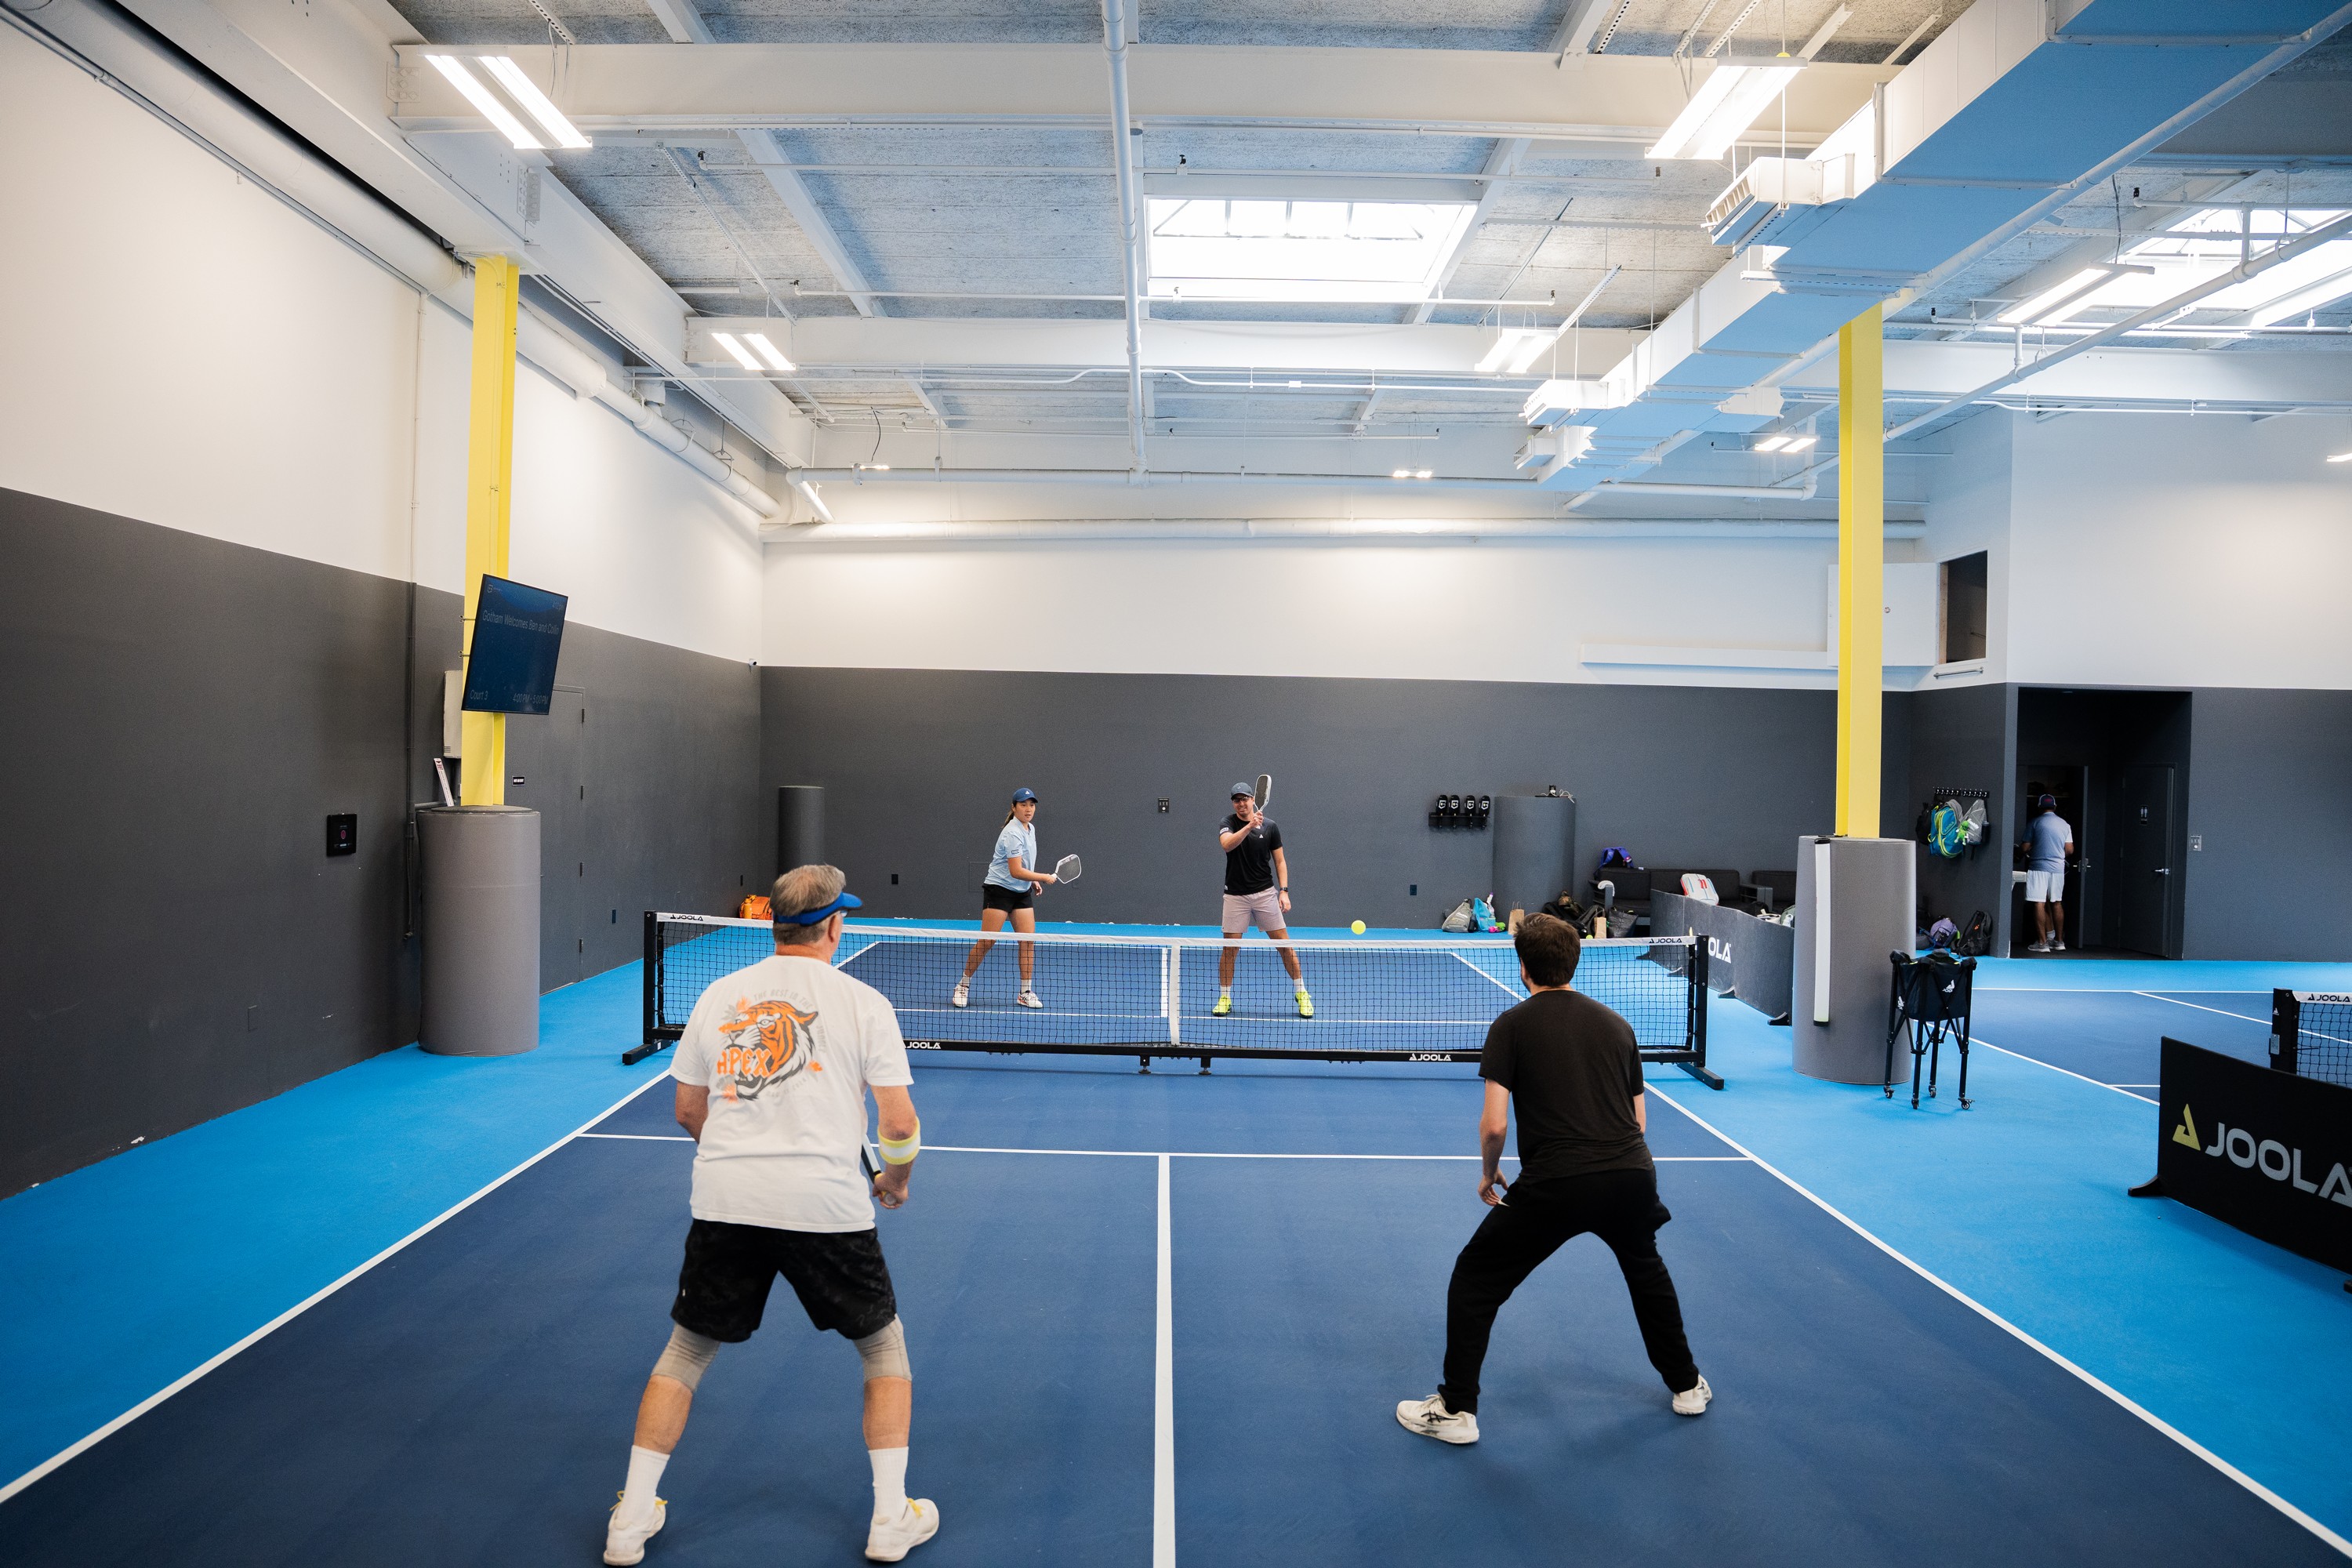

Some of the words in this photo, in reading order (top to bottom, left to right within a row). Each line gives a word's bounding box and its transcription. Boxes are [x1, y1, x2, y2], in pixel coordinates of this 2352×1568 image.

[482, 610, 503, 625] Gotham
[504, 614, 528, 630] Welcomes
[528, 619, 538, 630] Ben
[538, 622, 547, 633] and
[470, 689, 484, 700] Court
[484, 690, 488, 701] 3
[771, 989, 789, 997] BEST
[2316, 994, 2350, 1003] JOOLA
[906, 1041, 942, 1050] JOOLA
[717, 1047, 772, 1078] APEX
[2205, 1122, 2352, 1208] JOOLA
